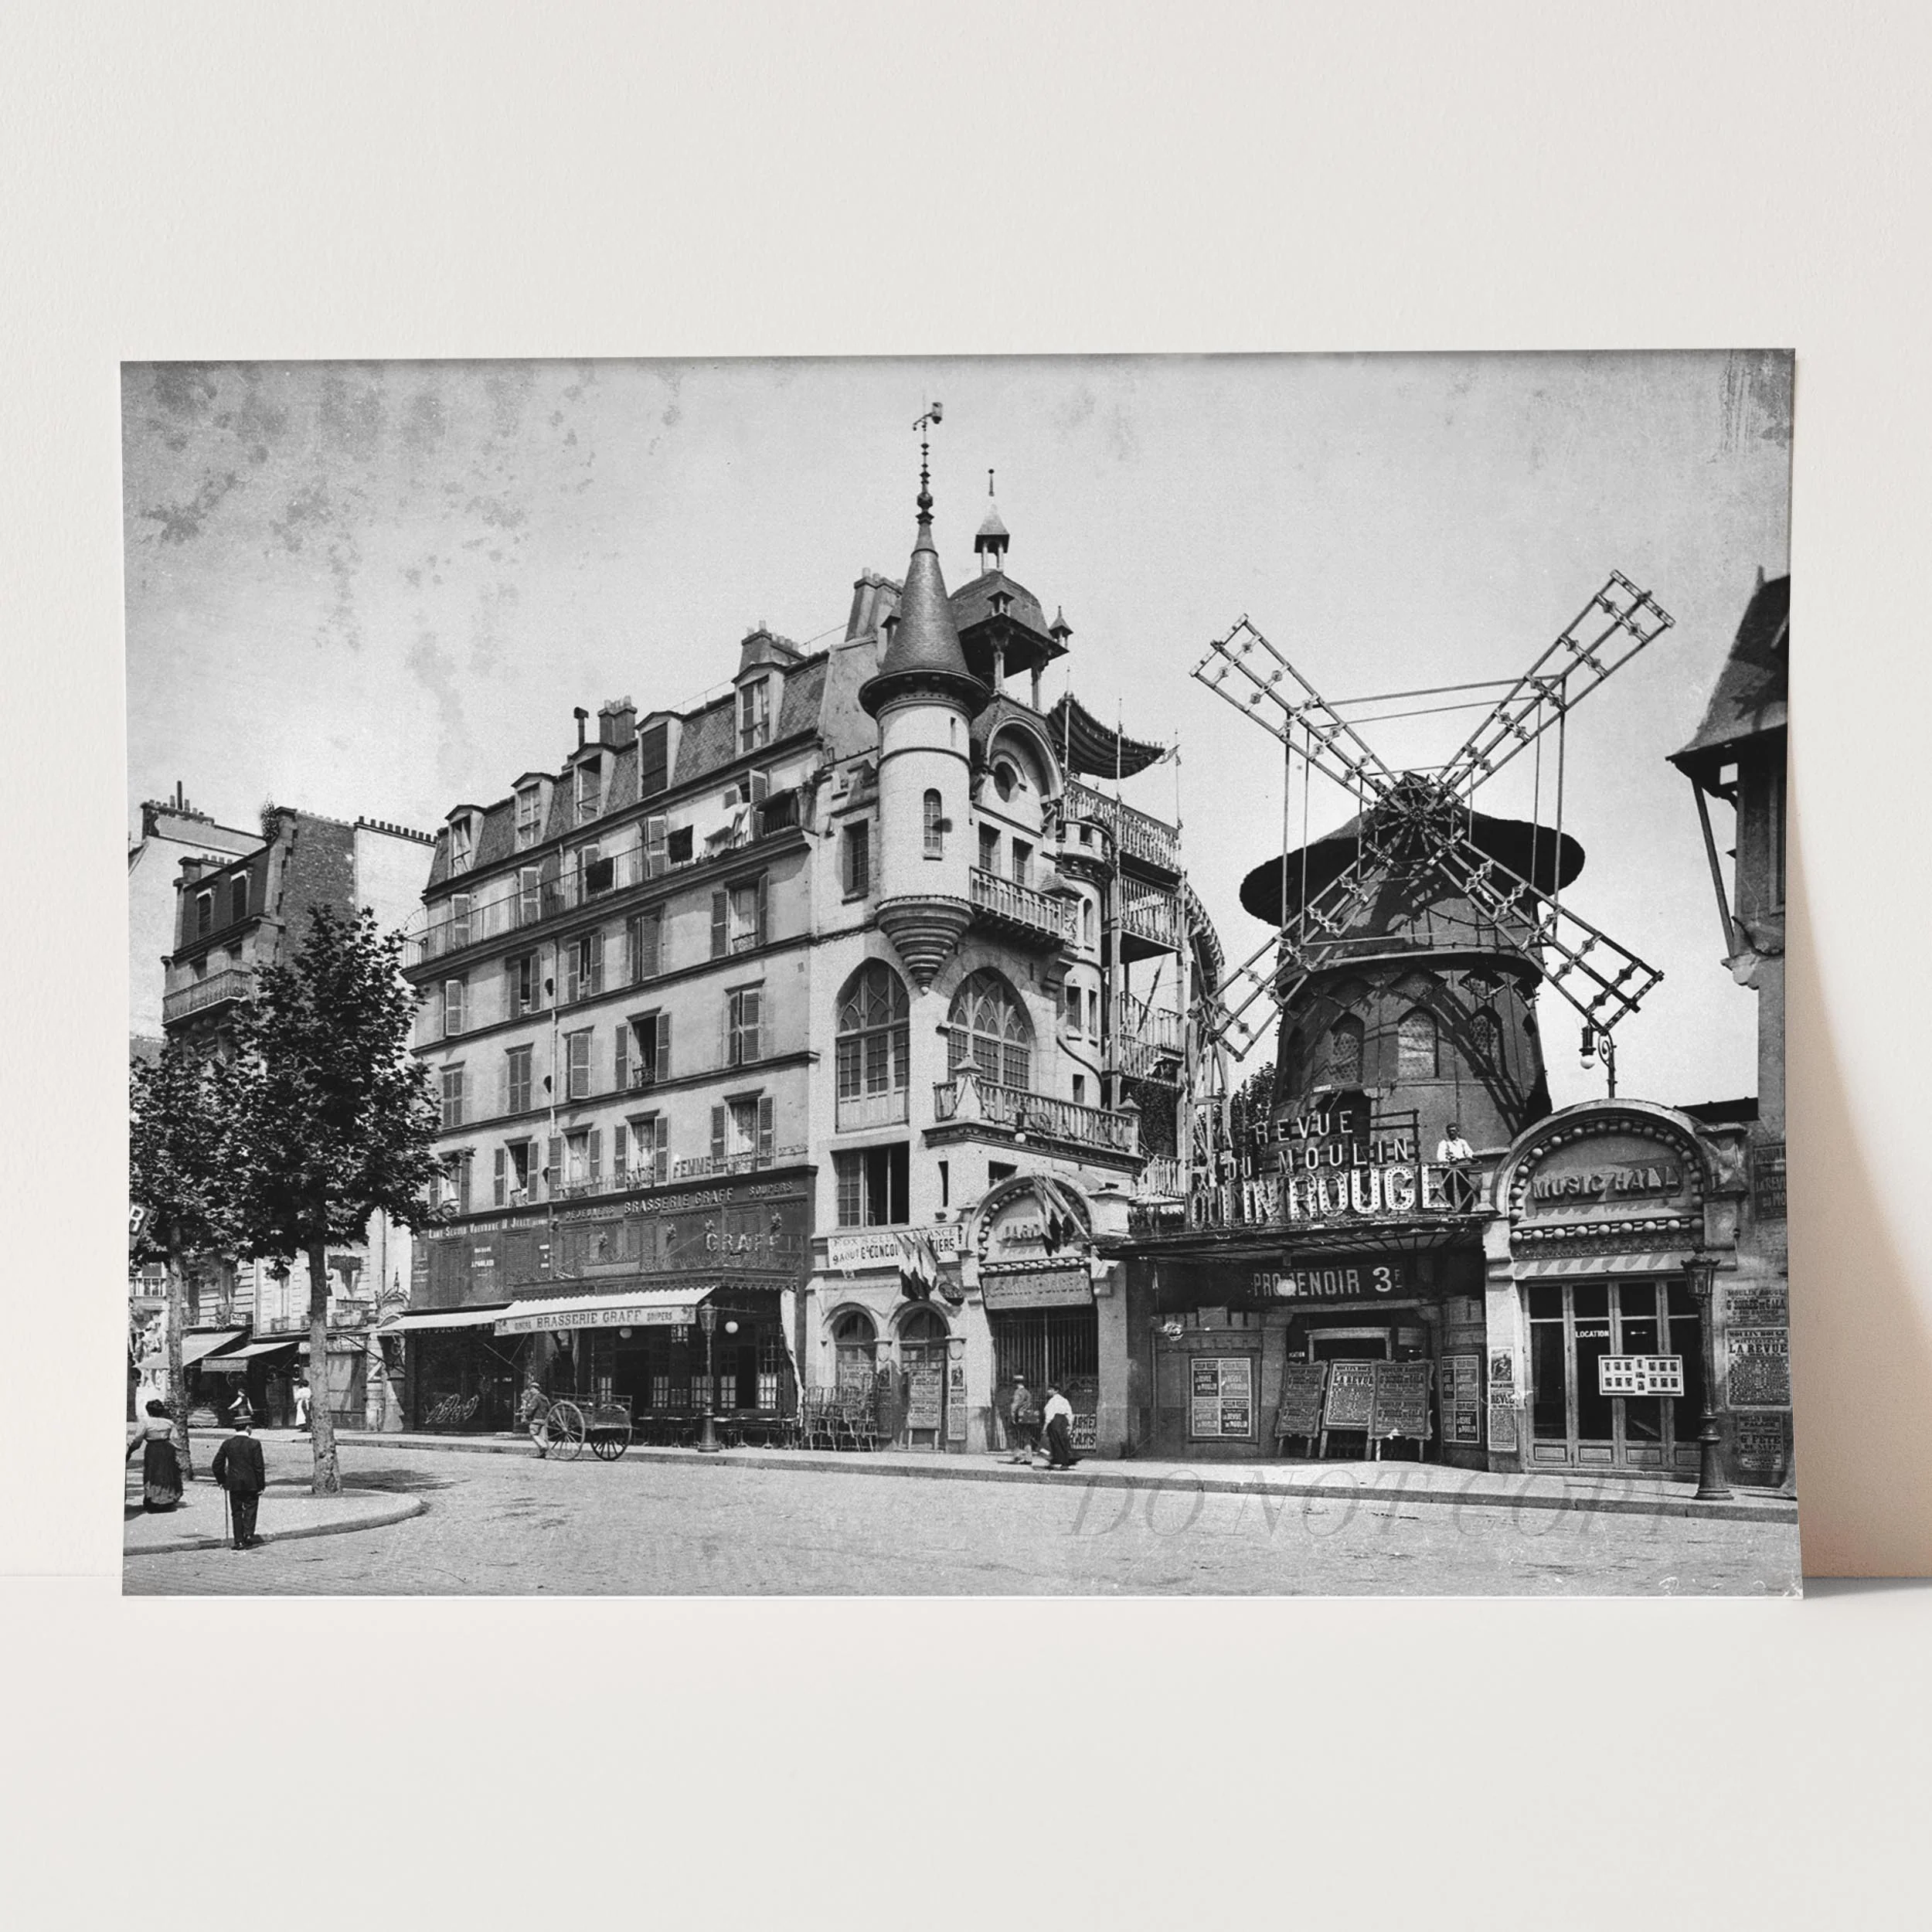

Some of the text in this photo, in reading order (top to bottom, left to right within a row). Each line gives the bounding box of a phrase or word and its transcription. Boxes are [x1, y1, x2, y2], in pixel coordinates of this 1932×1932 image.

[1255, 1110, 1353, 1145] REVUE
[1226, 1138, 1408, 1181] DU MOULIN
[748, 1182, 793, 1197] SOUPERS
[1289, 1159, 1454, 1221] ROUGE
[1533, 1166, 1679, 1198] MUSIC HALL
[624, 1192, 690, 1214] BRASSERIE
[695, 1187, 734, 1205] GRAFF
[536, 1312, 598, 1328] BRASSERIE
[602, 1310, 641, 1323] GRAFF
[1575, 1330, 1610, 1338] LOCATION
[1730, 1343, 1788, 1354] LA REVUE
[1347, 1376, 1373, 1386] REVUE
